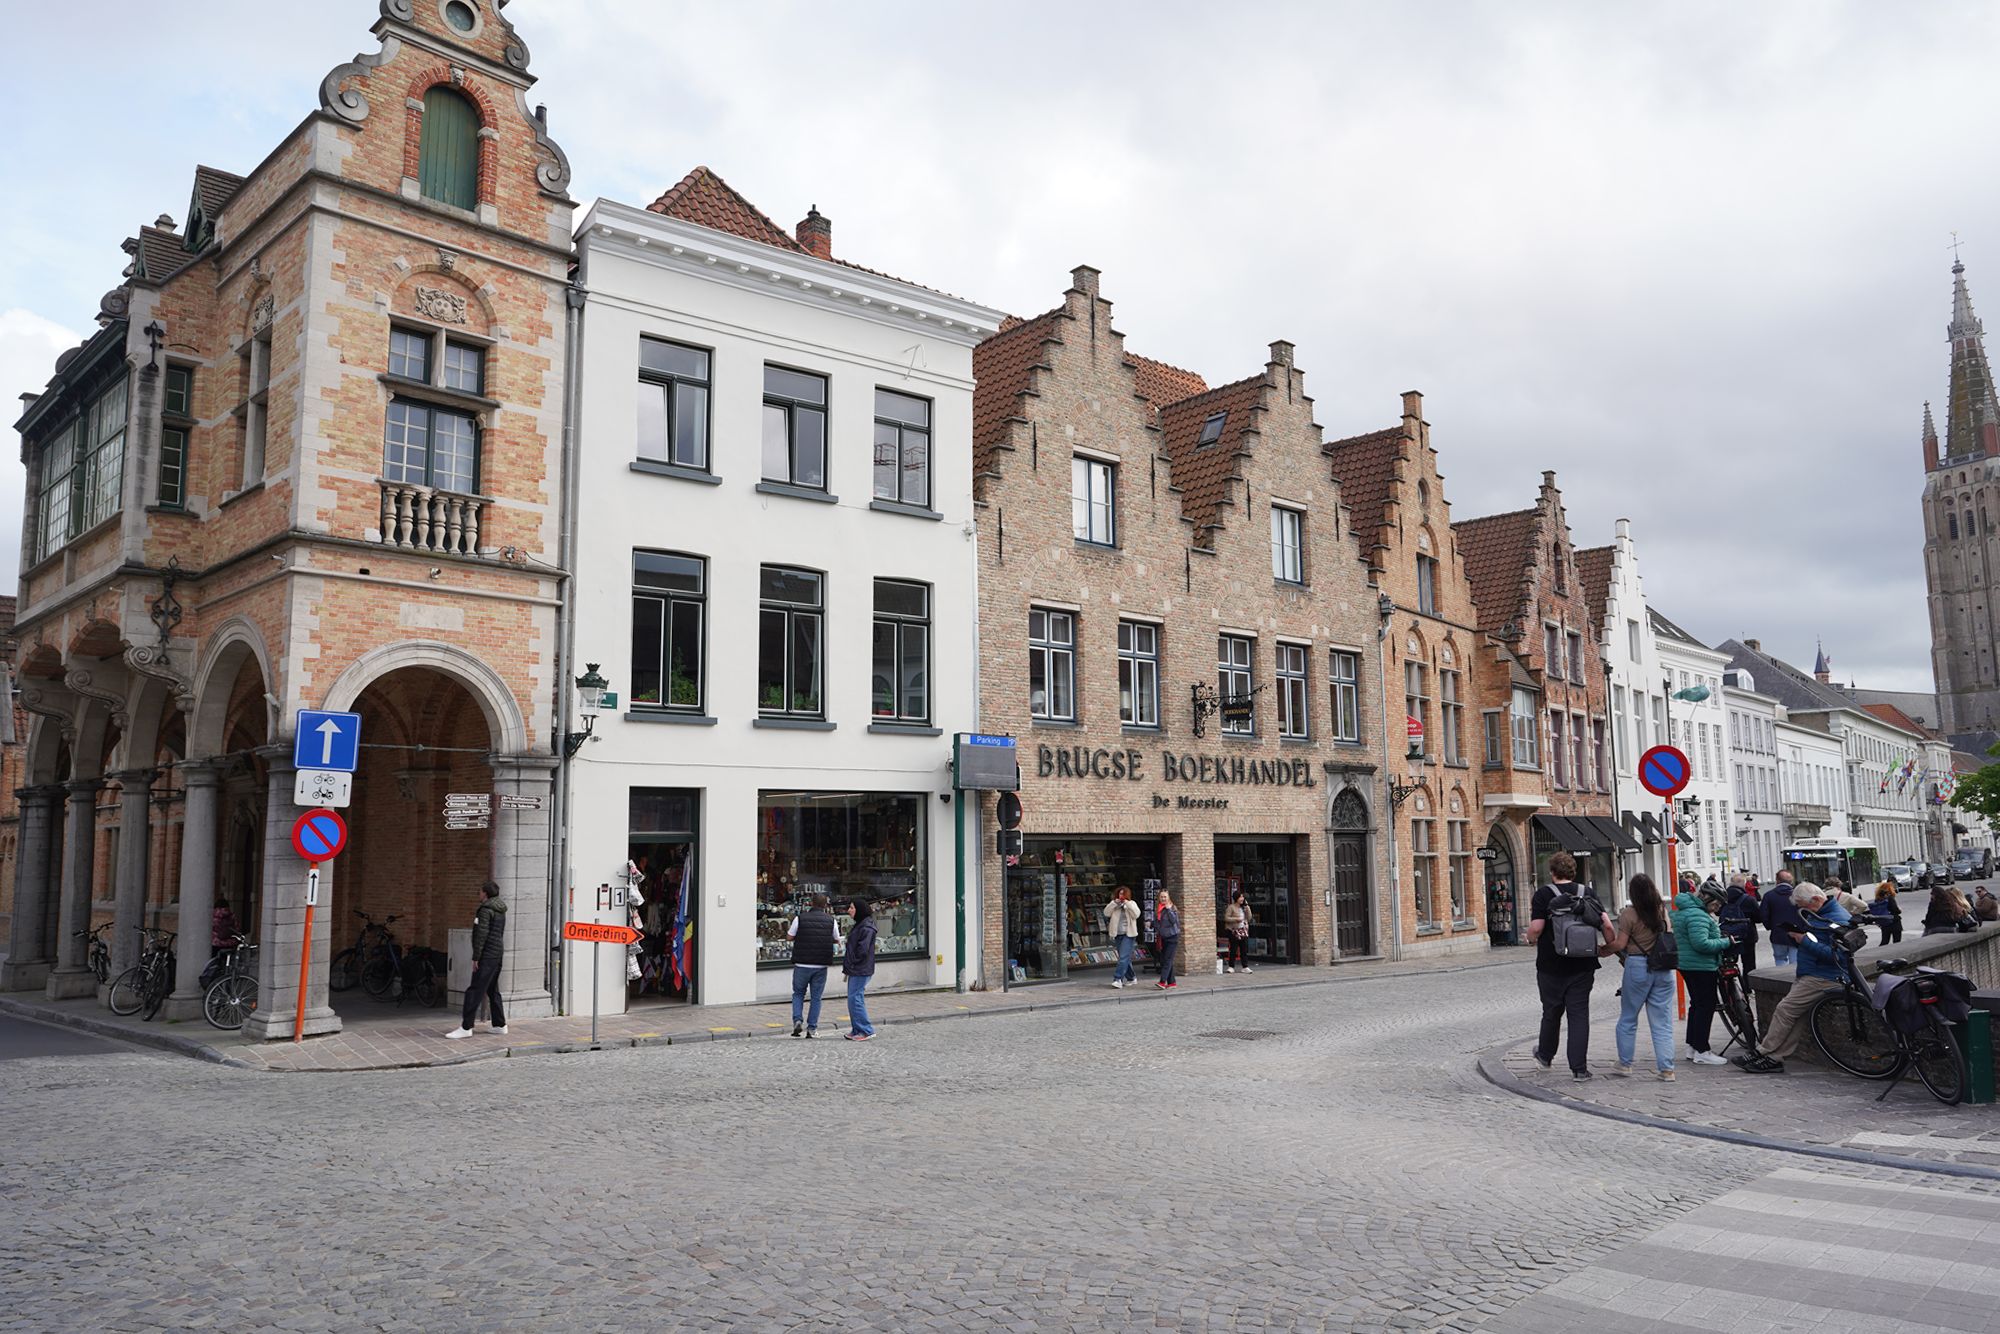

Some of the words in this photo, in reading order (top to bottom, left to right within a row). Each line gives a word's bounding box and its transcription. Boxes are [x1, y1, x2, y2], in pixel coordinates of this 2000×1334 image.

[976, 736, 1001, 746] Parking
[1038, 744, 1144, 781] BRUGSE
[1163, 751, 1317, 787] BOEKHANDEL
[1152, 793, 1170, 809] De
[1178, 796, 1229, 809] Meester
[616, 891, 622, 903] 1
[568, 925, 628, 943] Omleiding
